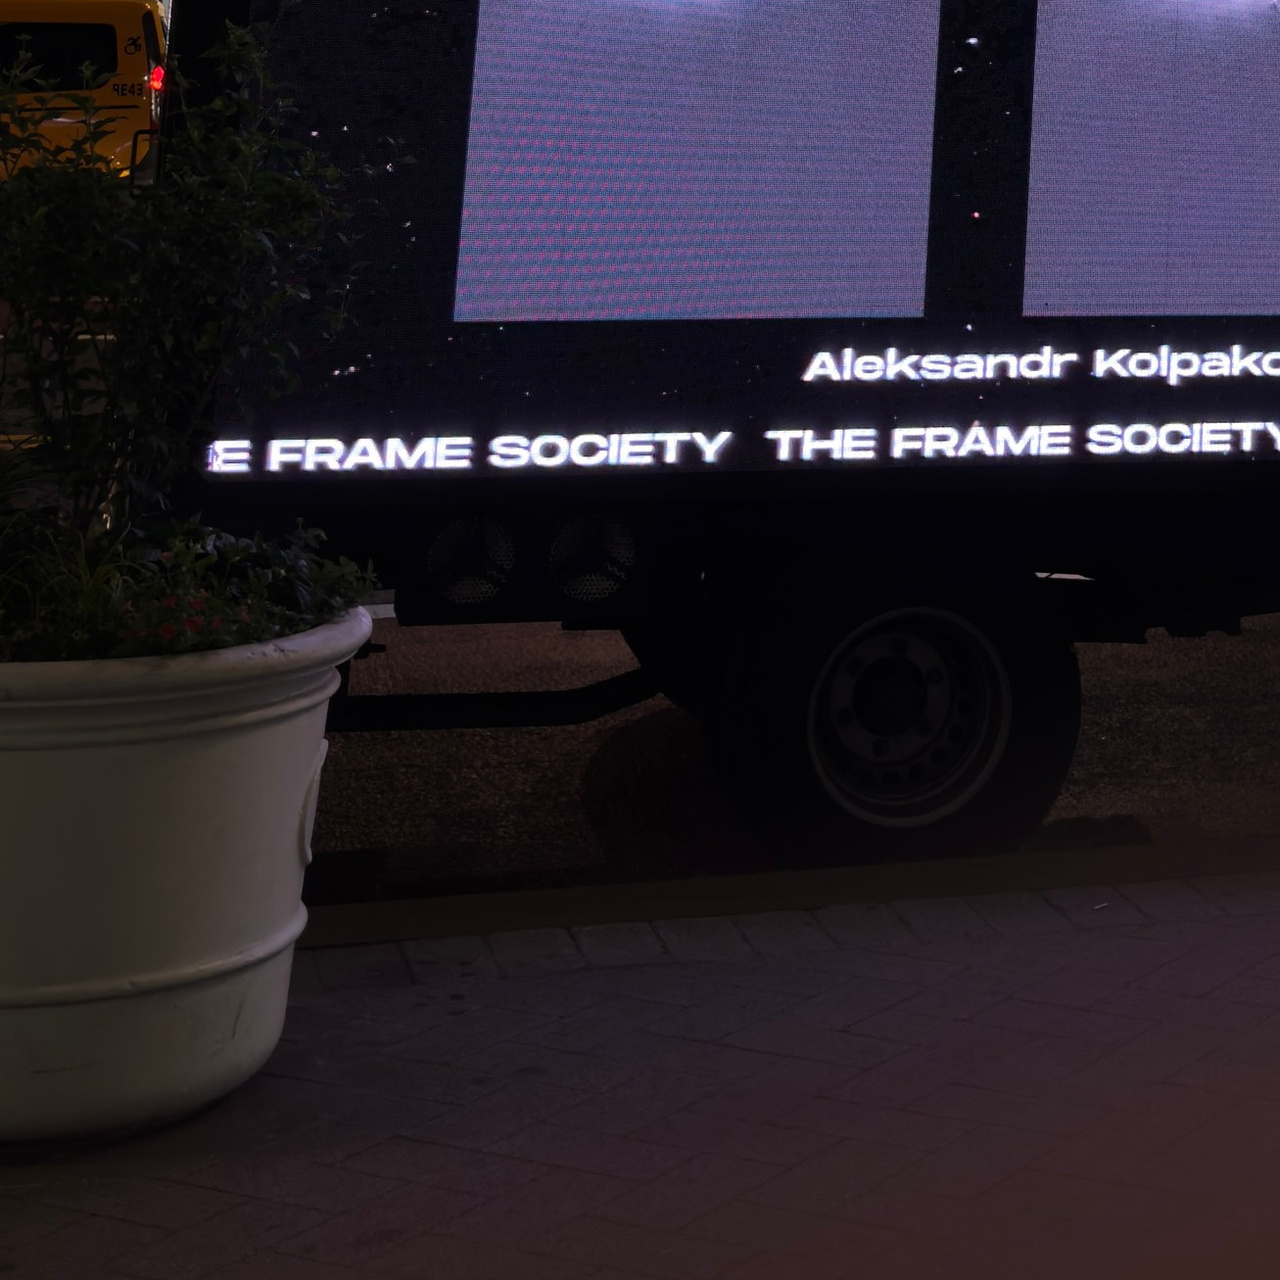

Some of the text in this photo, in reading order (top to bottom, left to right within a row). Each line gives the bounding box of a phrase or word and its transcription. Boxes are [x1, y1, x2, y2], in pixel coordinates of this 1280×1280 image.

[801, 345, 1080, 382] Aleksandr
[265, 437, 474, 472] FRAME
[487, 431, 733, 469] SOCIETY
[764, 427, 878, 461] THE
[890, 424, 1073, 459] FRAME
